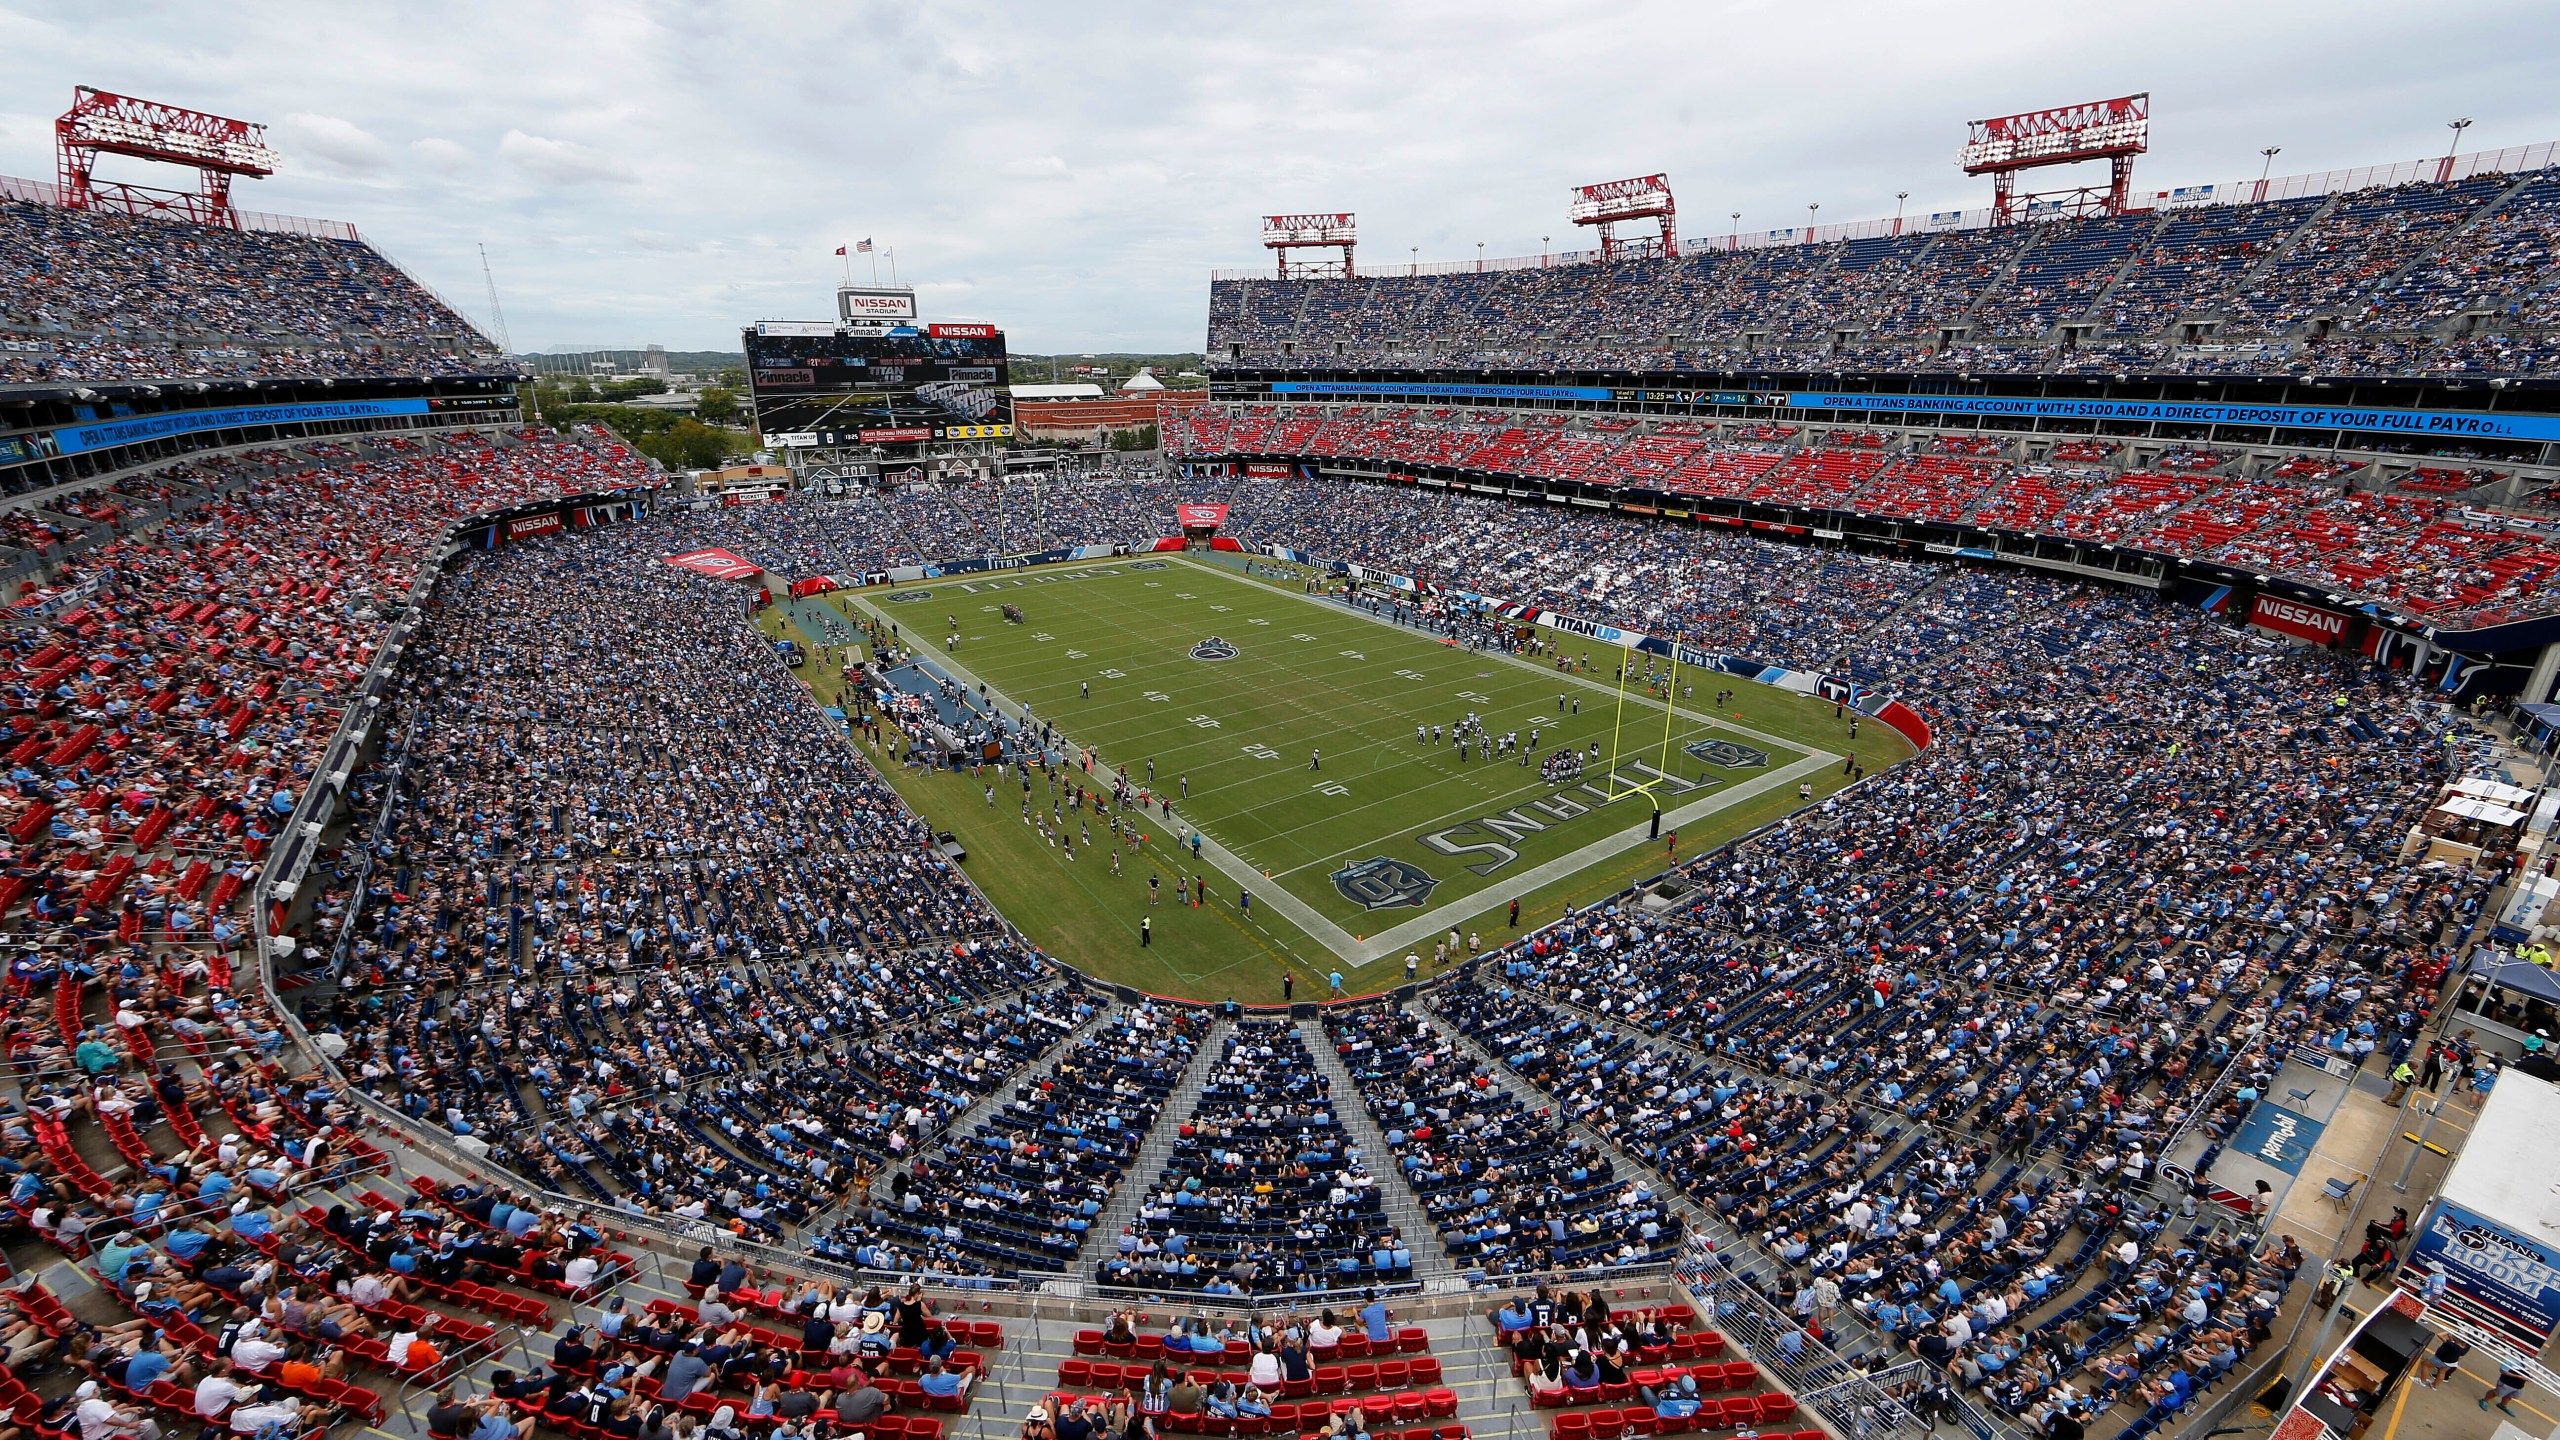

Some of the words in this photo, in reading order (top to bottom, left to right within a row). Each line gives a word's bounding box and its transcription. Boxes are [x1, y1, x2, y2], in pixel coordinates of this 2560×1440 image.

[2184, 186, 2202, 194] KEN
[2173, 192, 2211, 202] HOUSTON
[2028, 207, 2059, 216] HOLOVAK
[1931, 217, 1959, 225] GEORGE
[854, 299, 906, 308] NISSAN
[848, 328, 882, 336] Pinnacle
[939, 327, 987, 336] NISSAN
[758, 370, 810, 383] Pinnacle
[868, 366, 905, 376] TITAN
[951, 369, 993, 381] Pinnacle
[1345, 384, 1375, 392] BANKING
[1535, 389, 1551, 397] FULL
[1646, 392, 1665, 400] 13:25
[1737, 395, 1746, 403] 14
[977, 398, 997, 417] UP
[222, 411, 245, 424] DIRECT
[247, 409, 284, 422] DEPOSIT
[285, 409, 295, 419] OF
[295, 406, 323, 418] YOUR
[326, 405, 349, 416] FULL
[1823, 397, 1853, 407] OPEN
[1854, 397, 1863, 407] A
[1865, 398, 1905, 408] TITANS
[1907, 399, 1964, 411] BANKING
[1965, 401, 2034, 413] ACCOUNT
[2036, 402, 2075, 414] WITH
[2077, 402, 2114, 416] $100
[2115, 405, 2149, 417] AND
[2151, 406, 2161, 417] A
[2165, 406, 2226, 420] DIRECT
[2226, 408, 2299, 422] DEPOSIT
[2301, 411, 2327, 424] OF
[2329, 412, 2379, 426] YOUR
[2380, 414, 2425, 430] FULL
[2428, 416, 2513, 435] PAYROLL
[1248, 465, 1288, 473] NISSAN
[741, 492, 768, 500] PUCKETT'S
[512, 516, 559, 534] NISSAN
[1709, 516, 1729, 524] NISSAN
[1769, 524, 1786, 532] xfinity
[1925, 544, 1953, 554] Pinnacle
[734, 571, 754, 580] NISSAN
[2257, 599, 2343, 634] NISSAN
[1553, 614, 1621, 641] TITANUP
[1339, 650, 1366, 662] 40
[1667, 642, 1731, 673] TITANS
[1098, 668, 1127, 679] 50
[1393, 669, 1426, 682] 30
[1142, 691, 1170, 703] 40
[1187, 714, 1221, 729] 30
[1241, 743, 1279, 760] 20
[1312, 780, 1351, 797] 10
[1417, 757, 1725, 876] TITANS
[2260, 1113, 2298, 1162] permobil
[1357, 1238, 1364, 1249] 8
[2476, 1226, 2540, 1261] TITANS
[1275, 1265, 1285, 1277] 31
[2447, 1242, 2540, 1295] ROOM
[2430, 1249, 2454, 1263] OFFICIAL
[2490, 1278, 2525, 1298] TENNESSEE
[2524, 1295, 2545, 1307] TITANS
[2454, 1269, 2473, 1281] Locker
[2471, 1278, 2488, 1289] Room
[2486, 1286, 2508, 1298] located
[2512, 1298, 2531, 1310] Nissan
[2530, 1307, 2554, 1321] Stadium
[1539, 1311, 1549, 1327] 8
[590, 1404, 600, 1423] 8
